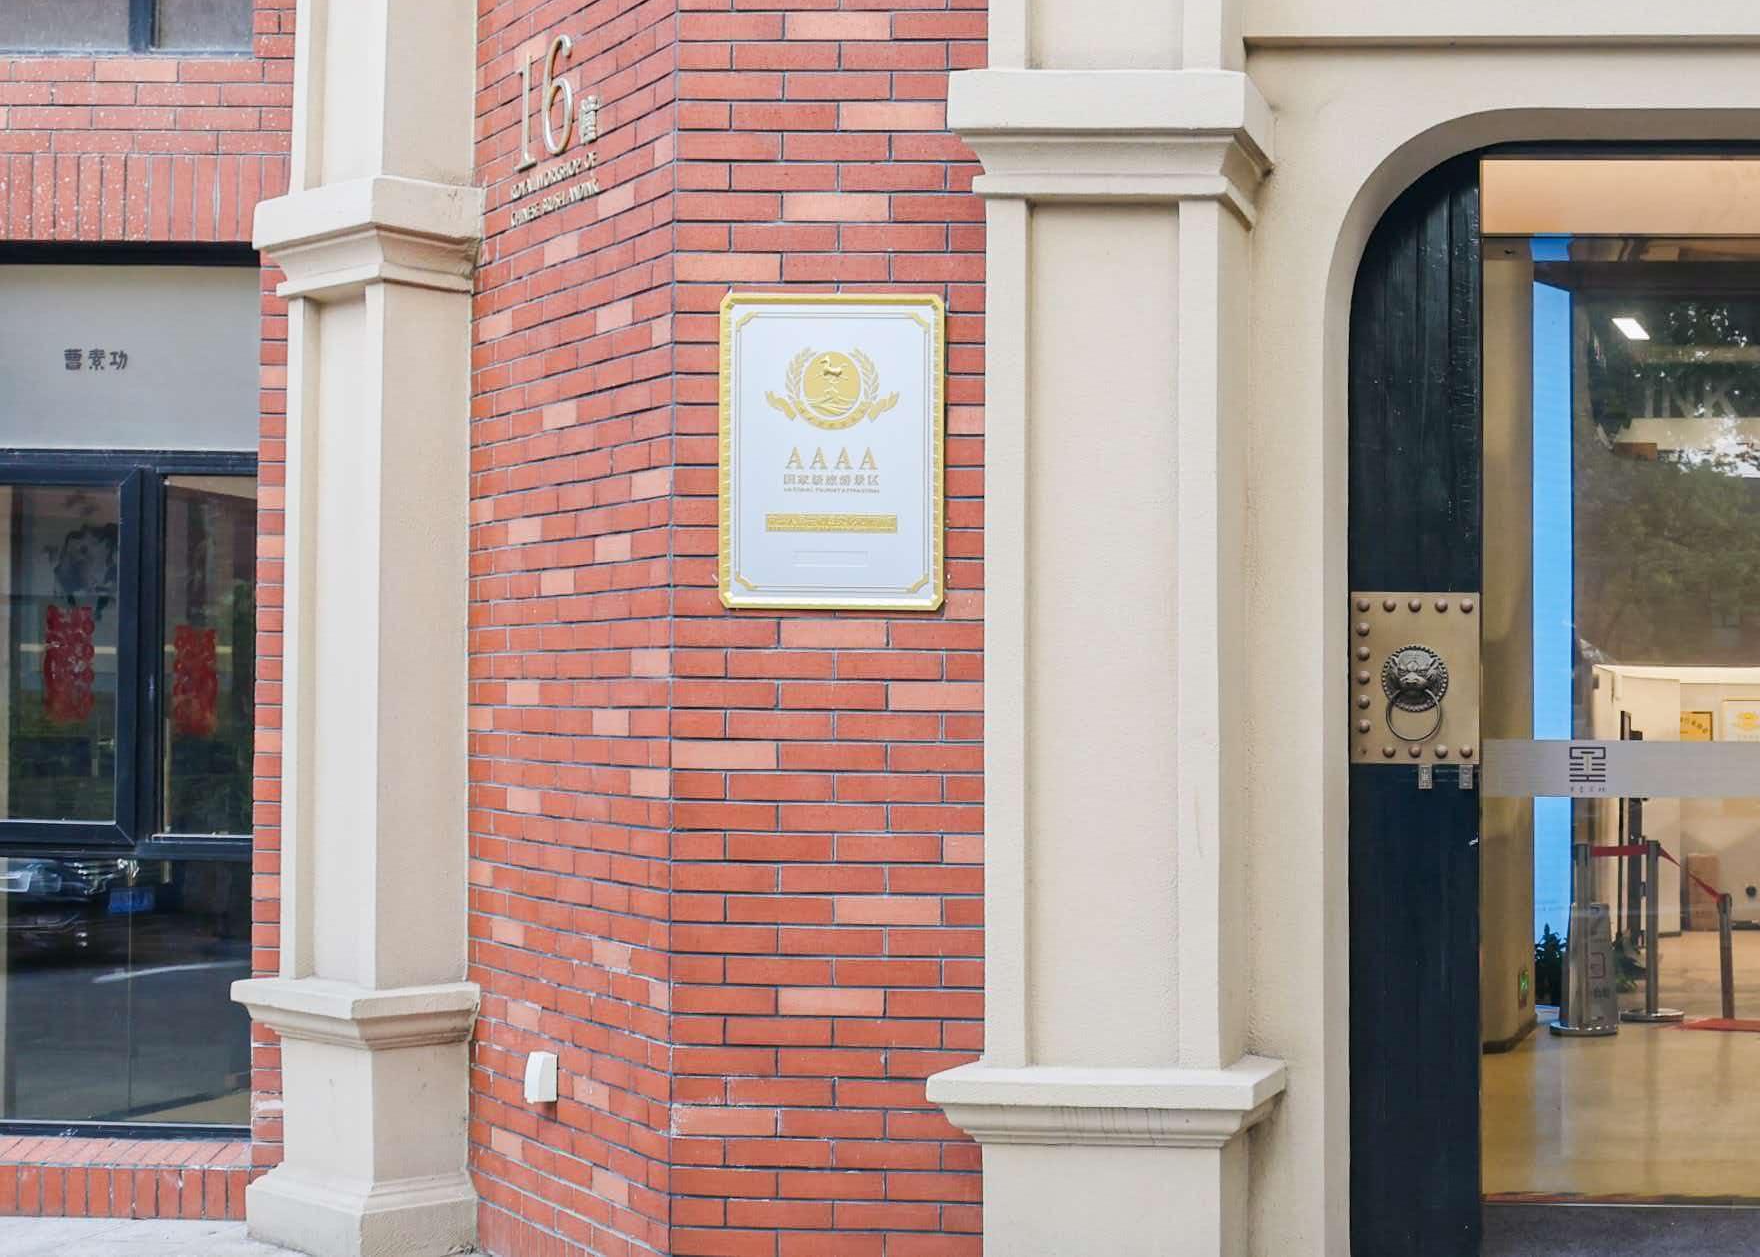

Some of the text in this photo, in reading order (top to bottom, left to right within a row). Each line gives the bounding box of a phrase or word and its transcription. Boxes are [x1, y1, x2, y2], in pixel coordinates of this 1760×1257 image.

[513, 34, 574, 173] 16
[64, 348, 128, 371] 曹素功
